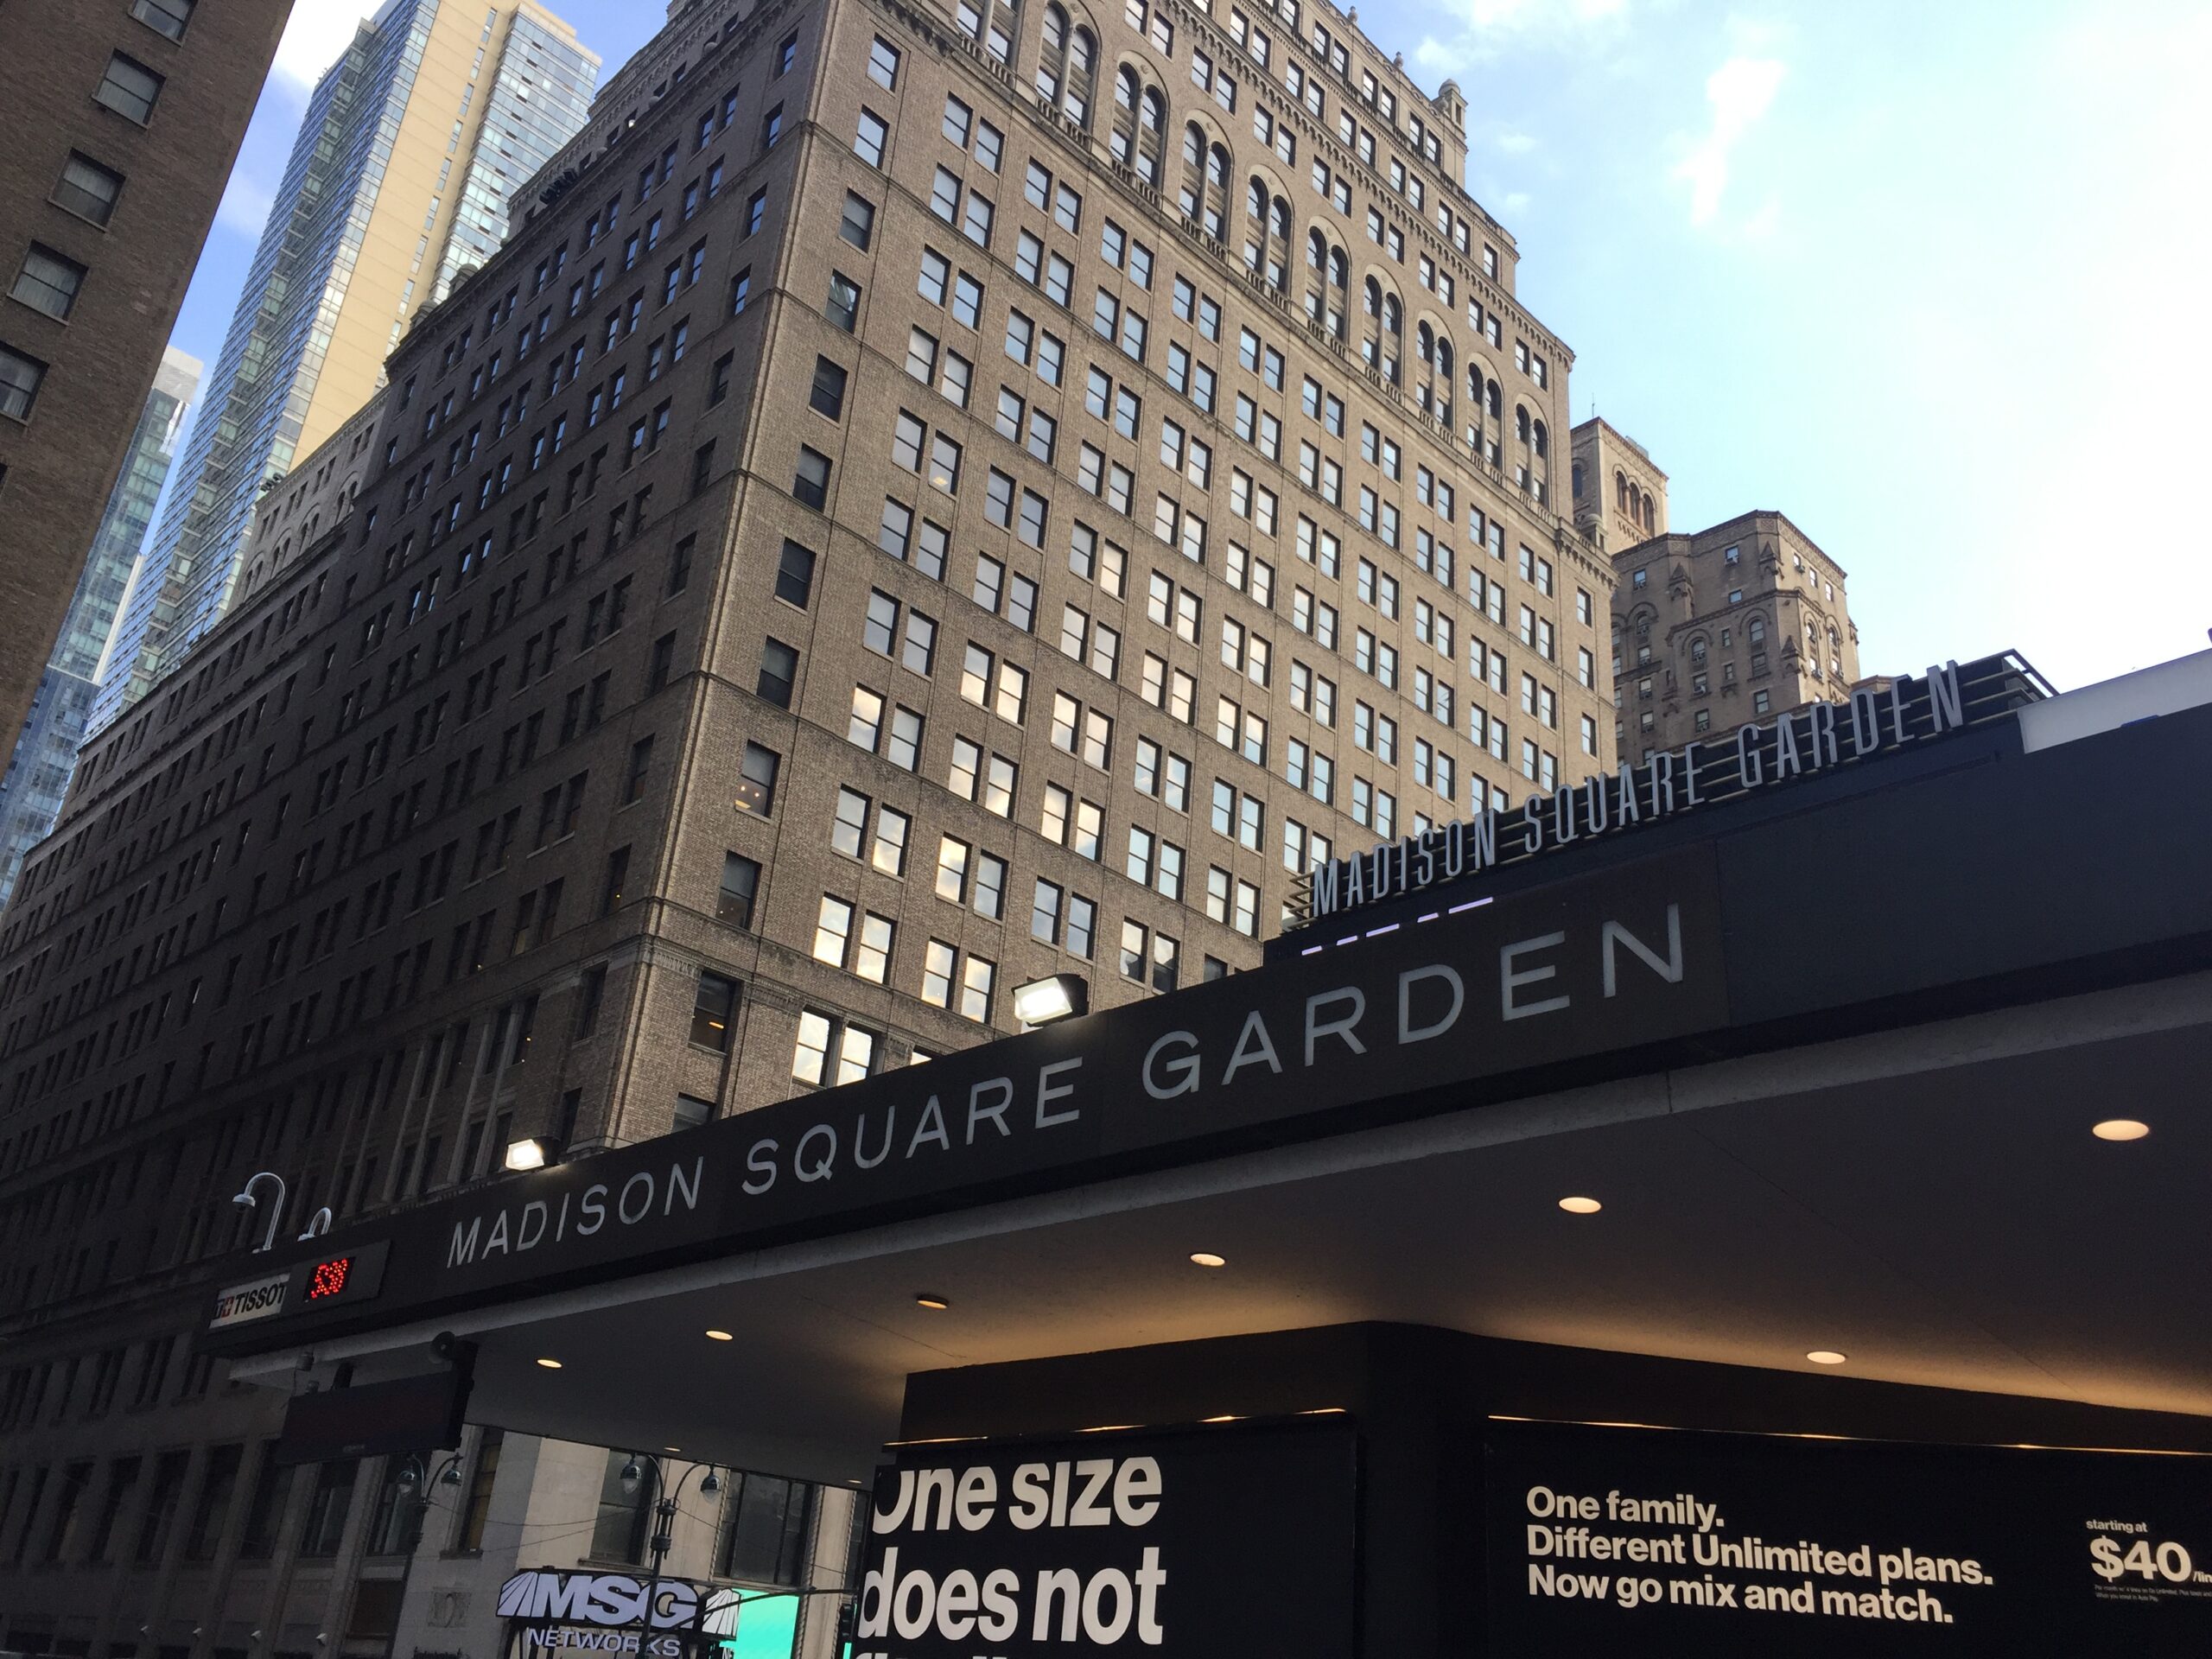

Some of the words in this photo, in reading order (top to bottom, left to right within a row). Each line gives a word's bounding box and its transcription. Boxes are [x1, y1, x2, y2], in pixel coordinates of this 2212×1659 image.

[1312, 810, 1497, 918] MADISON
[1523, 741, 1707, 855] SQUARE
[1738, 659, 1967, 791] GARDEN
[446, 1156, 704, 1268] MADISON
[741, 1057, 1083, 1195] SQUARE
[1142, 903, 1683, 1099] GARDEN
[233, 1282, 288, 1316] TISSOT
[1008, 1456, 1162, 1530] size
[1526, 1485, 1600, 1520] One
[1605, 1491, 1725, 1533] family.
[1527, 1524, 1687, 1565] Different
[1692, 1533, 1872, 1577] Unlimited
[1878, 1547, 1993, 1586] plans.
[2086, 1519, 2134, 1534] starting
[2135, 1522, 2148, 1533] at
[2089, 1535, 2192, 1583] $40
[531, 1573, 699, 1630] MSG
[857, 1546, 1020, 1643] does
[1032, 1547, 1167, 1645] not
[1529, 1563, 1610, 1599] Now
[1616, 1577, 1663, 1608] go
[1669, 1573, 1738, 1608] mix
[1744, 1581, 1815, 1614] and
[1821, 1588, 1954, 1624] match.
[527, 1628, 682, 1657] NETWORKS
